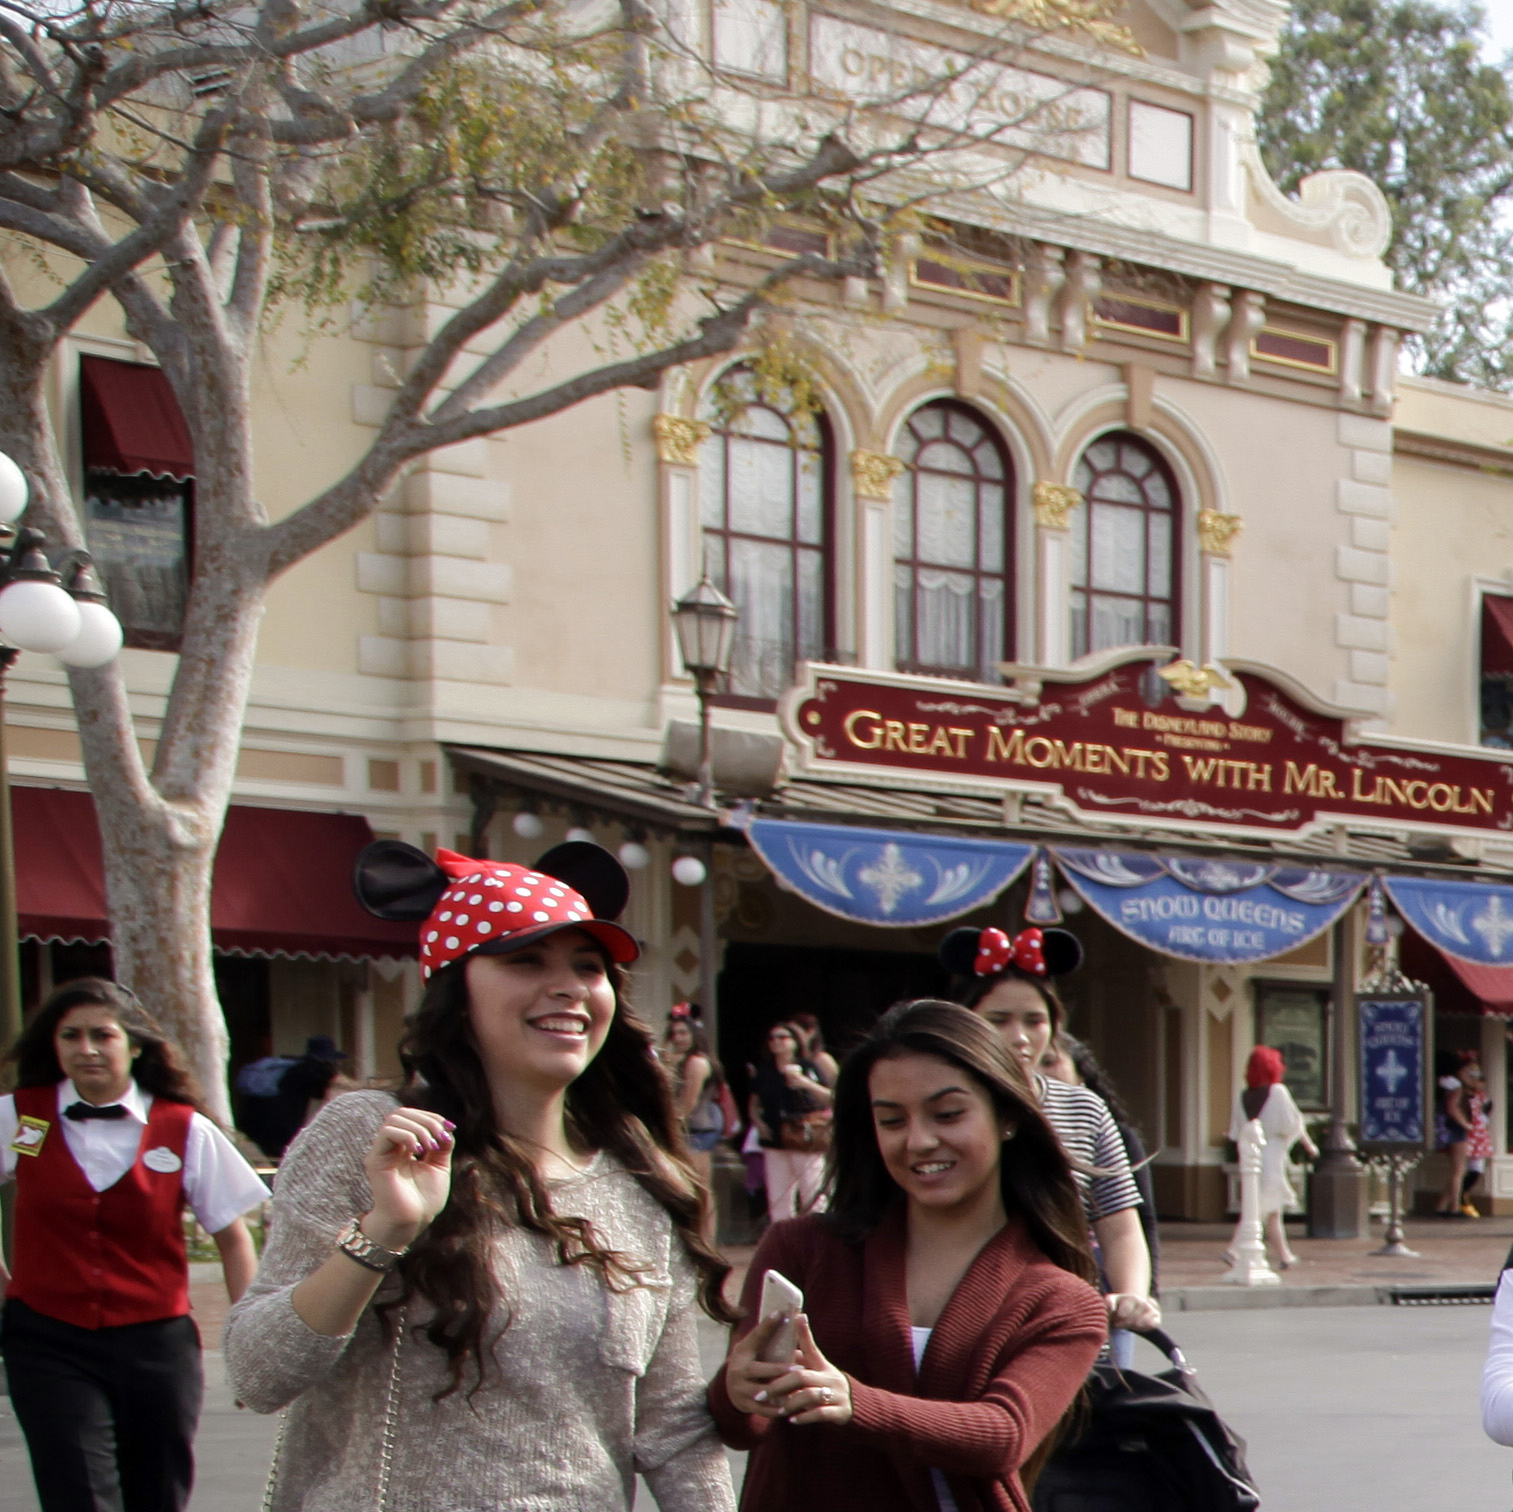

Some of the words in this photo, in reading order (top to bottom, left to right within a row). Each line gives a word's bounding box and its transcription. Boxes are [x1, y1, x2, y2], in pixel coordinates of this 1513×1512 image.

[1143, 711, 1228, 738] DISNEYLAND
[1228, 720, 1274, 744] STORY
[842, 708, 976, 760] GREAT
[984, 724, 1172, 783] MOMENTS
[1180, 754, 1273, 794] WITH
[1282, 759, 1347, 799] MR.
[1351, 767, 1496, 816] LINCOLN
[1120, 894, 1201, 924] SNOW
[1203, 896, 1306, 936] QUEENS
